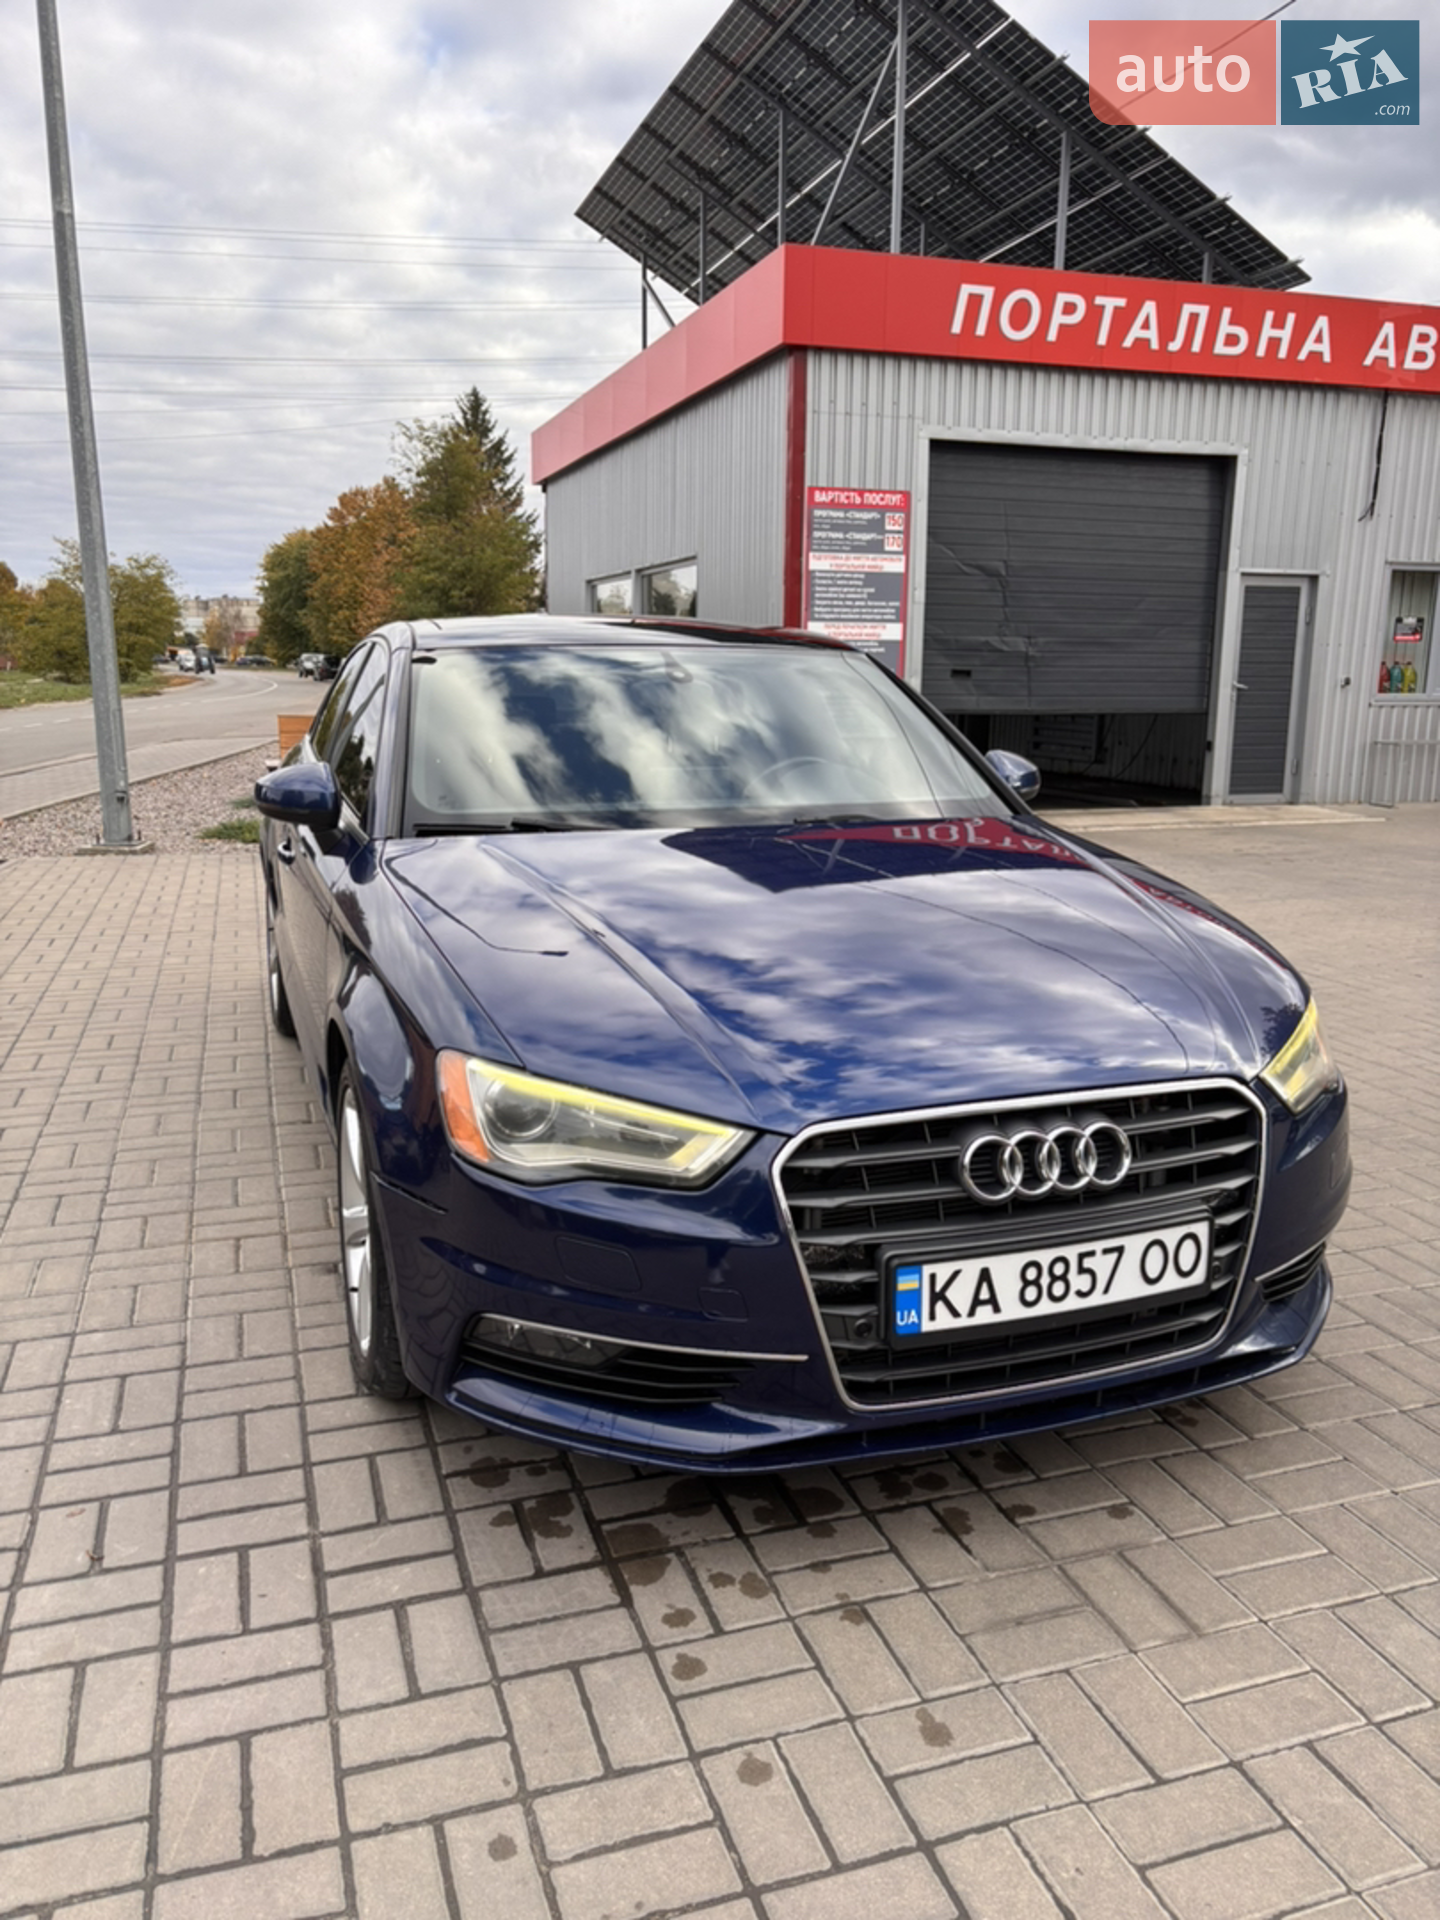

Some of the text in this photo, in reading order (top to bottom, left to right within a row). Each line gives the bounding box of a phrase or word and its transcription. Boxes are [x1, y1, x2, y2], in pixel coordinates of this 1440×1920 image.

[950, 283, 1438, 371] ПОРТАЛЬНА АВ
[814, 490, 905, 507] ВАРТІСТЬ ПОСЛУГ:
[886, 514, 904, 528] 150
[886, 535, 903, 549] 170
[928, 1232, 1202, 1322] KA 8857 OO
[896, 1310, 919, 1326] UA
